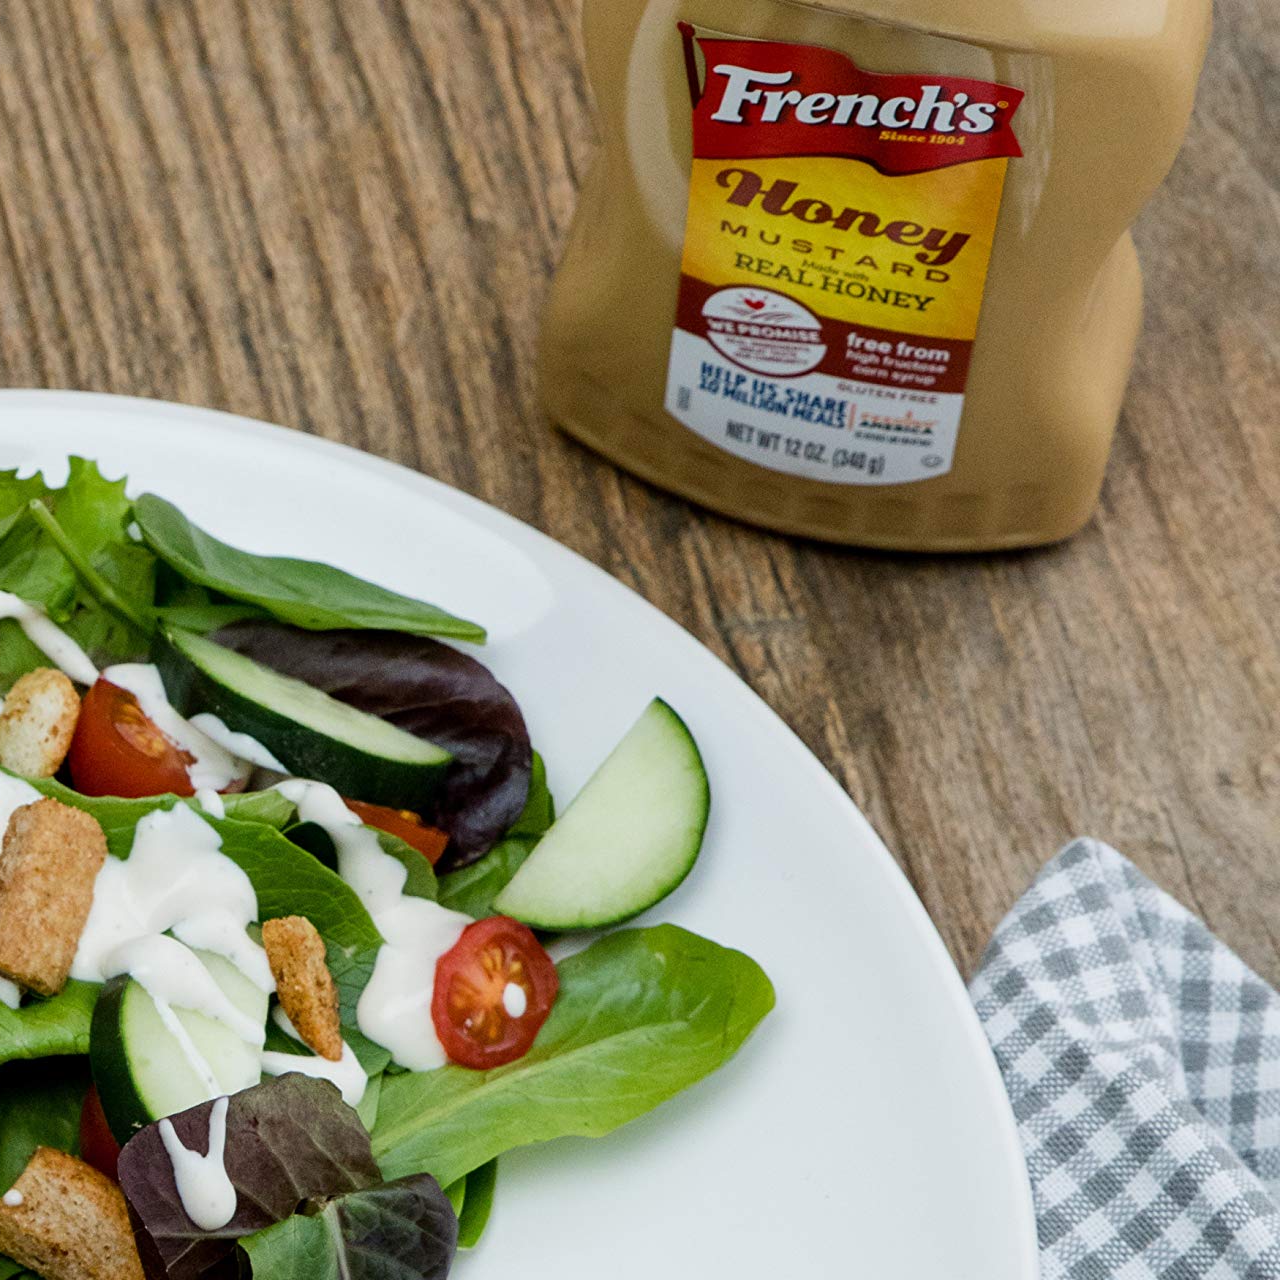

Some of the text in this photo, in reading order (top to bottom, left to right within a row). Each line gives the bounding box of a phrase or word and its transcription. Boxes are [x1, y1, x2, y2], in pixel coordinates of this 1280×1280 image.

[710, 64, 996, 134] French's
[879, 130, 966, 146] Since 1904
[715, 167, 972, 266] Honey
[720, 219, 951, 284] MUSTARD
[734, 252, 936, 312] REAL HONEY
[801, 258, 870, 283] Made with
[708, 319, 821, 342] WE PROMISE
[847, 331, 950, 362] free from
[846, 349, 947, 374] high fructose
[852, 364, 937, 386] corn syrup
[700, 361, 848, 413] HELP US SHARE
[837, 383, 937, 404] GLUTEN FREE
[723, 384, 789, 416] MILLION
[792, 407, 848, 429] MEALS
[725, 418, 755, 443] NET
[756, 429, 782, 452] WT
[785, 437, 803, 458] 12
